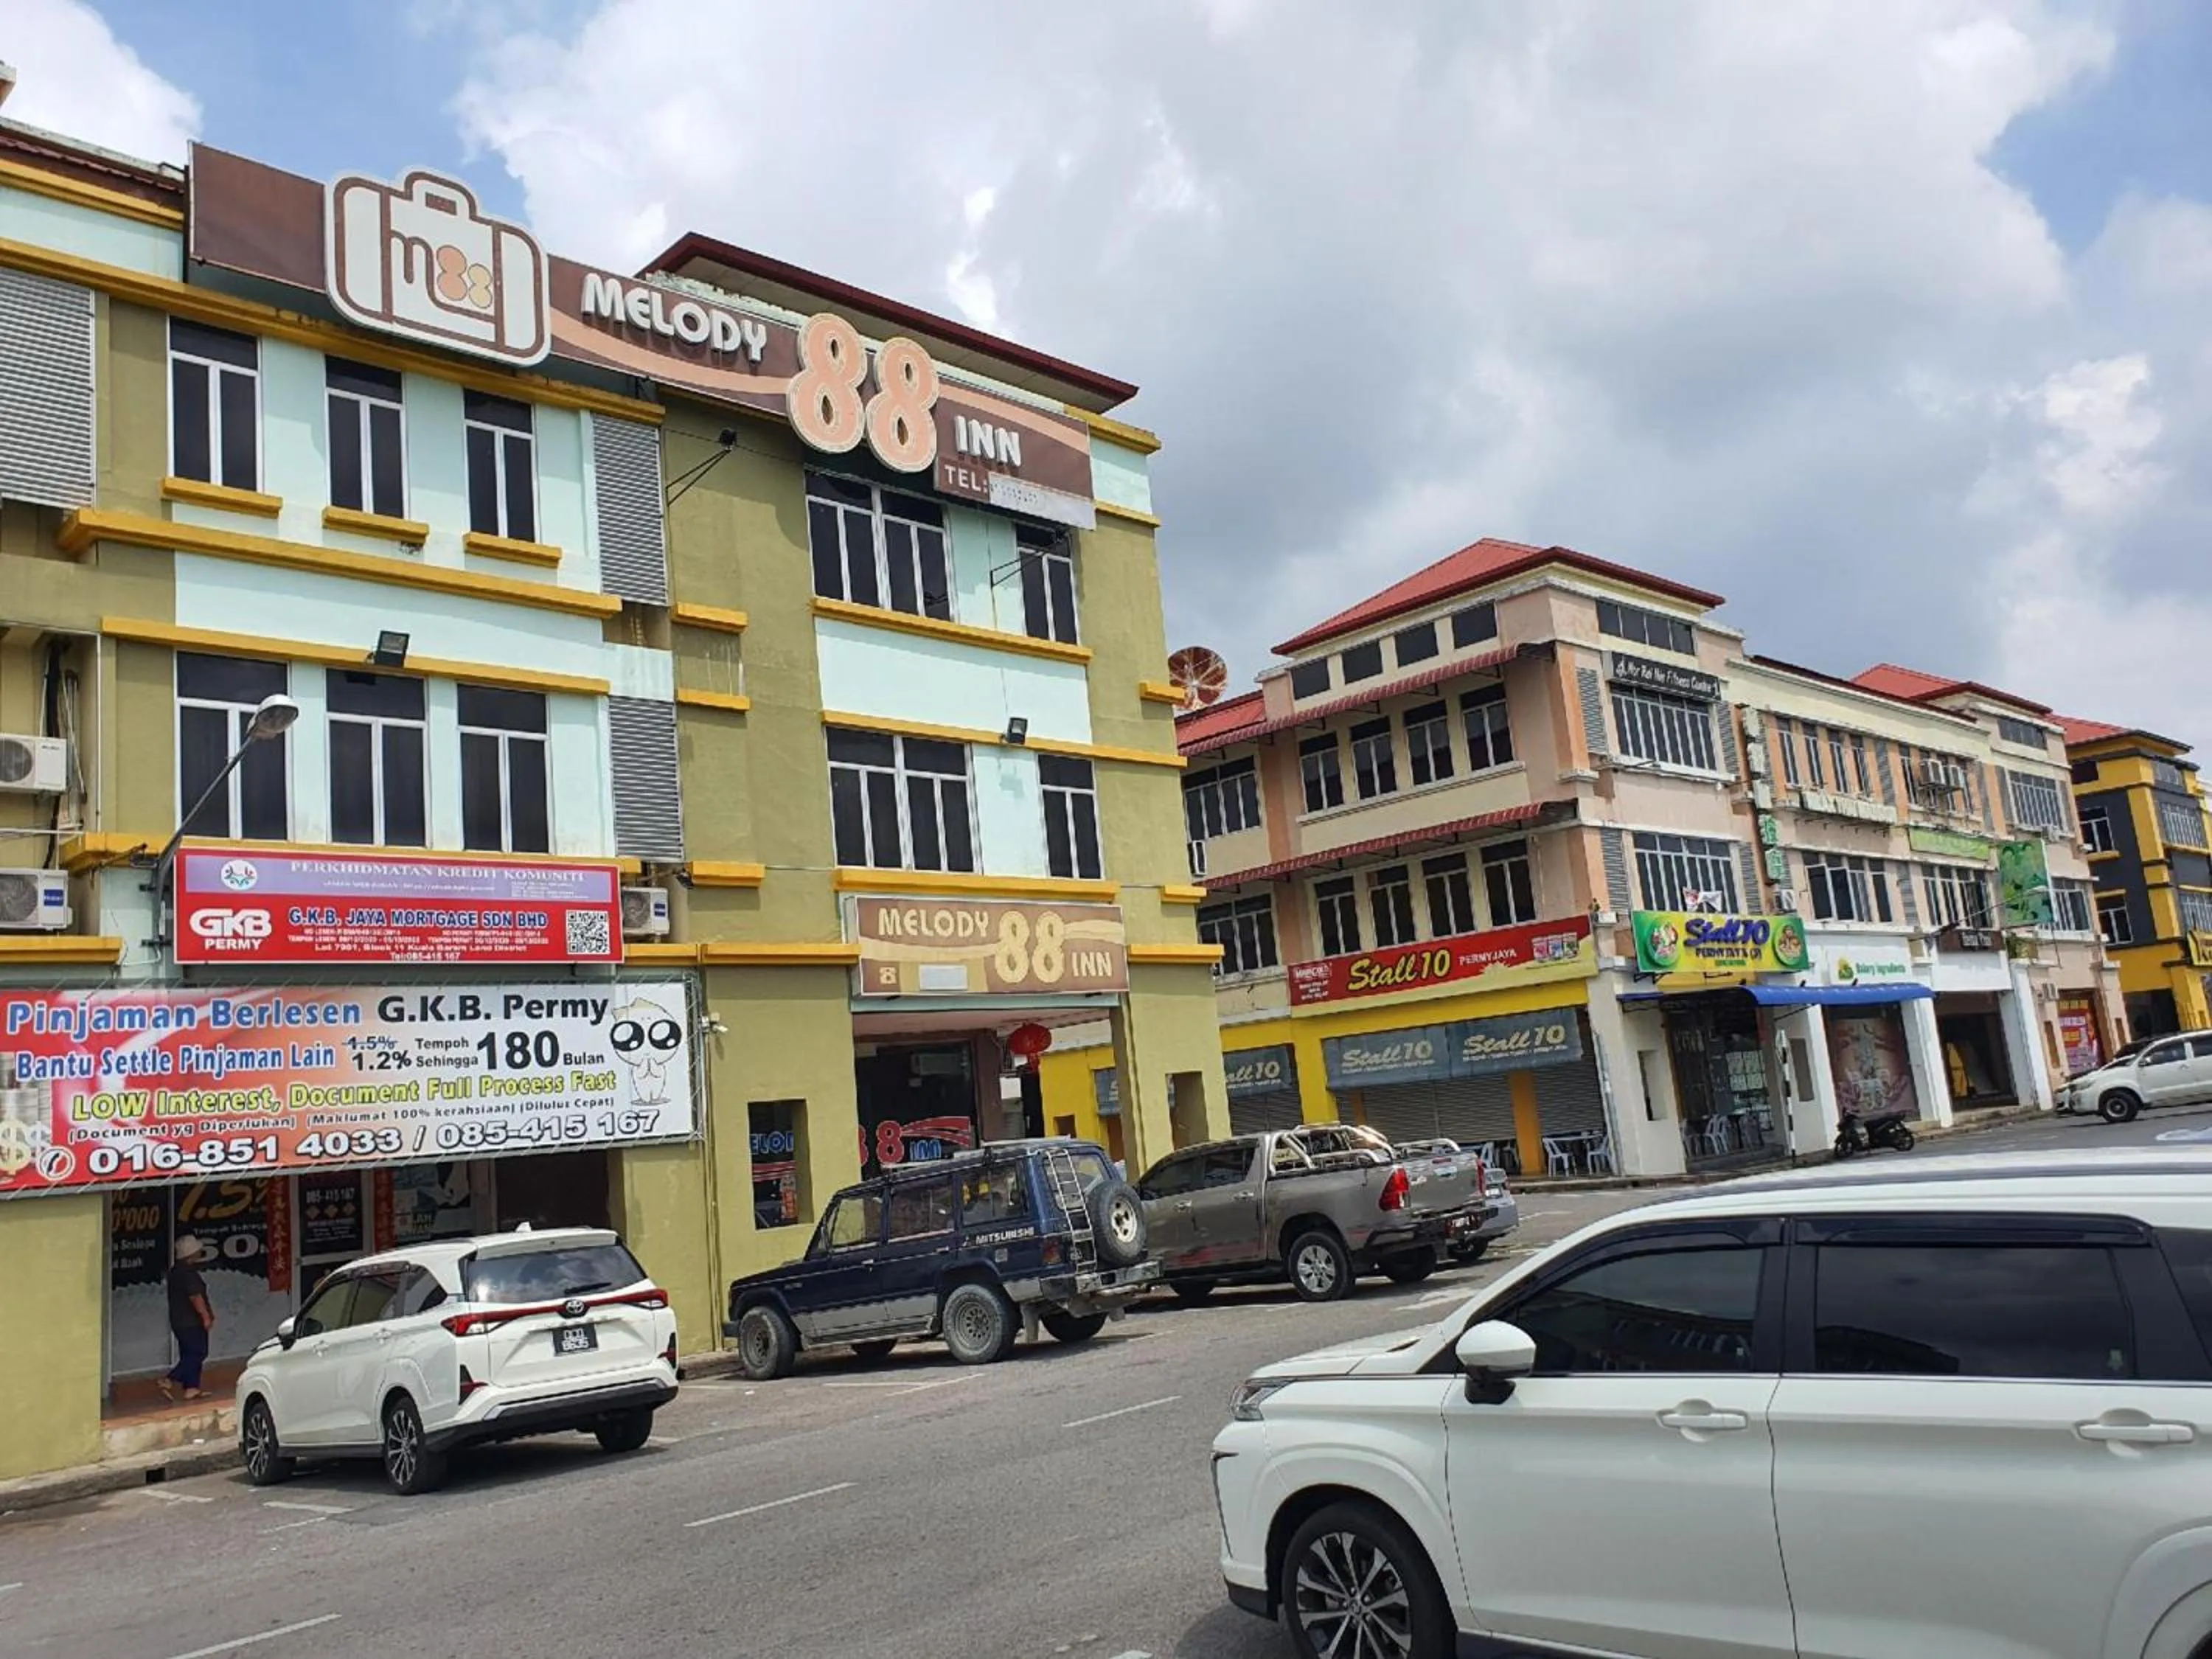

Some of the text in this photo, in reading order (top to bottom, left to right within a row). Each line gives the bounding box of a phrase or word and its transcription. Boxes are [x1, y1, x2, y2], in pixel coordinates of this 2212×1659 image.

[582, 273, 1021, 474] MELODY 88 INN
[945, 465, 989, 493] TEL:
[291, 860, 585, 883] PERKHIDMATAN KREDIT KOMUNITI
[189, 908, 273, 938] GKB
[288, 907, 549, 929] G.K.B. JAYA MORTGAGE SDN BHD
[204, 938, 263, 950] PERMY
[878, 908, 1113, 984] MELODY 88 INN
[7, 994, 609, 1042] Pinjaman Berlesen G.K.B. Permy
[16, 1040, 336, 1082] Bantu Settle Pinjaman Lain
[352, 1051, 412, 1071] 1.2%
[415, 1030, 560, 1070] Tempoh 180
[416, 1052, 605, 1069] Sehingga Bulan
[72, 1071, 617, 1121] LOW Interest, Document Full Process Fast
[393, 1107, 431, 1121] 100%
[88, 1107, 661, 1175] 016-851 4033 / 085-415 167
